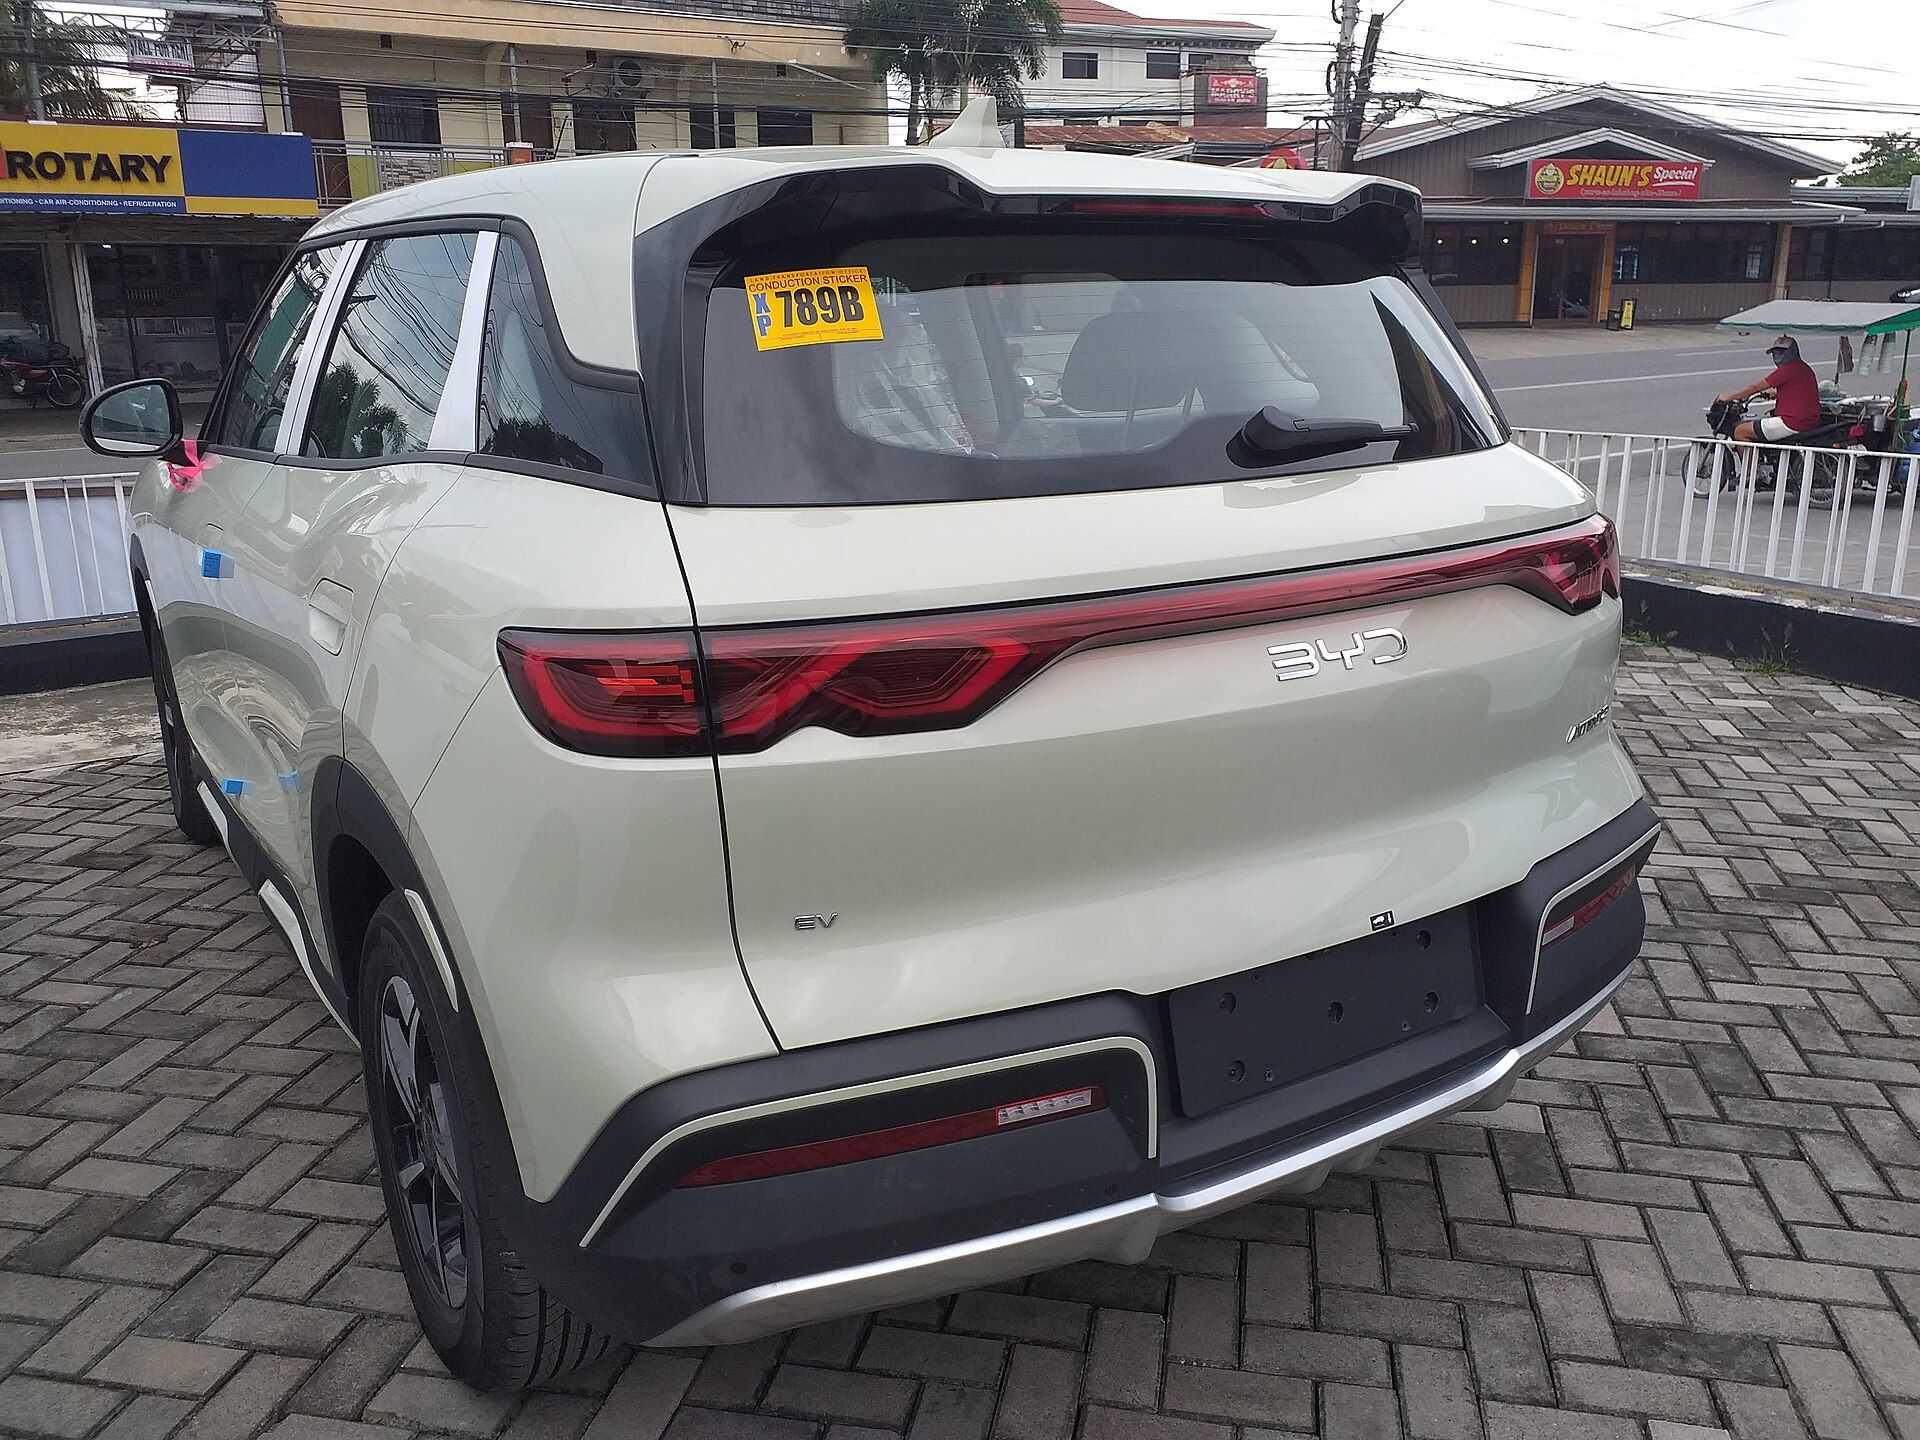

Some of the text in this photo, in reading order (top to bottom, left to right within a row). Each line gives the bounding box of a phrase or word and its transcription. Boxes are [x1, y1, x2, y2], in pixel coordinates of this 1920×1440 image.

[5, 150, 172, 184] ROTARY
[1566, 163, 1698, 188] SHAUN'S Special
[38, 198, 55, 206] CAR
[55, 199, 119, 208] AIR-CONDITIONING
[122, 200, 177, 209] REFRIGERATION
[748, 274, 869, 293] CONDUCTION STICKER
[750, 276, 770, 284] LAND
[774, 285, 865, 328] 789B
[1266, 626, 1409, 682] BYD
[794, 912, 838, 931] EV
